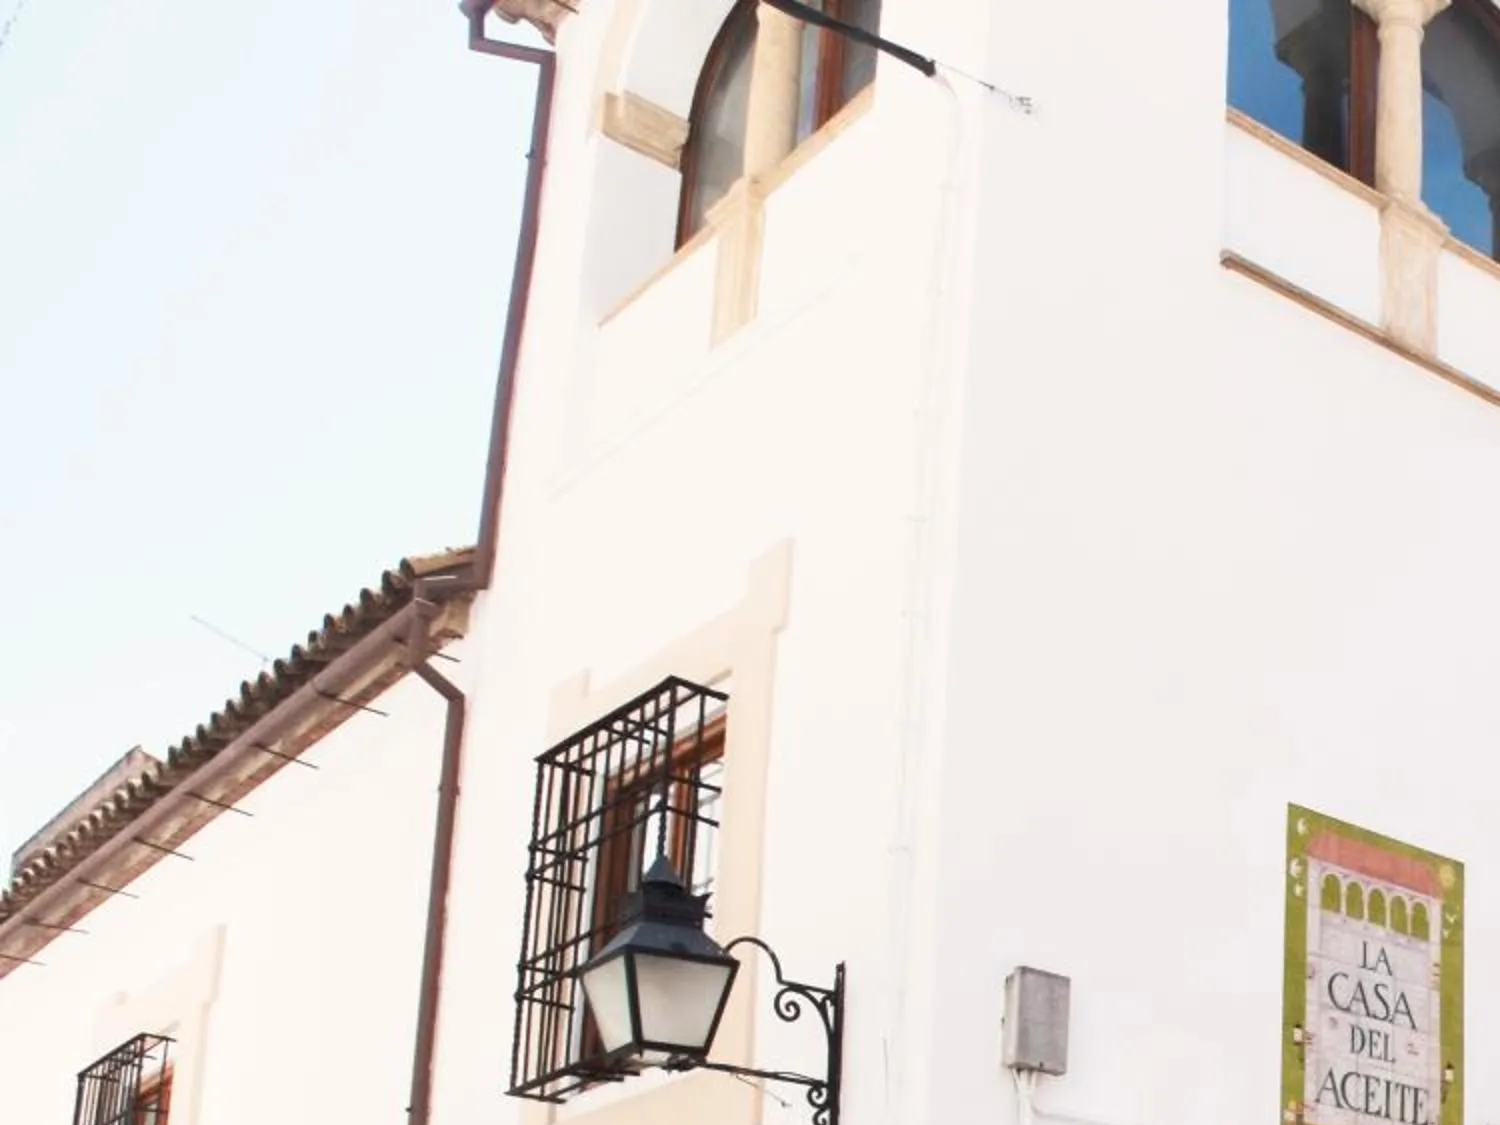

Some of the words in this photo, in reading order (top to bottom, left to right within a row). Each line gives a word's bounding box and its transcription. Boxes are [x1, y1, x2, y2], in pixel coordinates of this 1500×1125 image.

[1359, 940, 1393, 976] LA
[1327, 971, 1418, 1031] CASA
[1349, 1023, 1396, 1064] DEL
